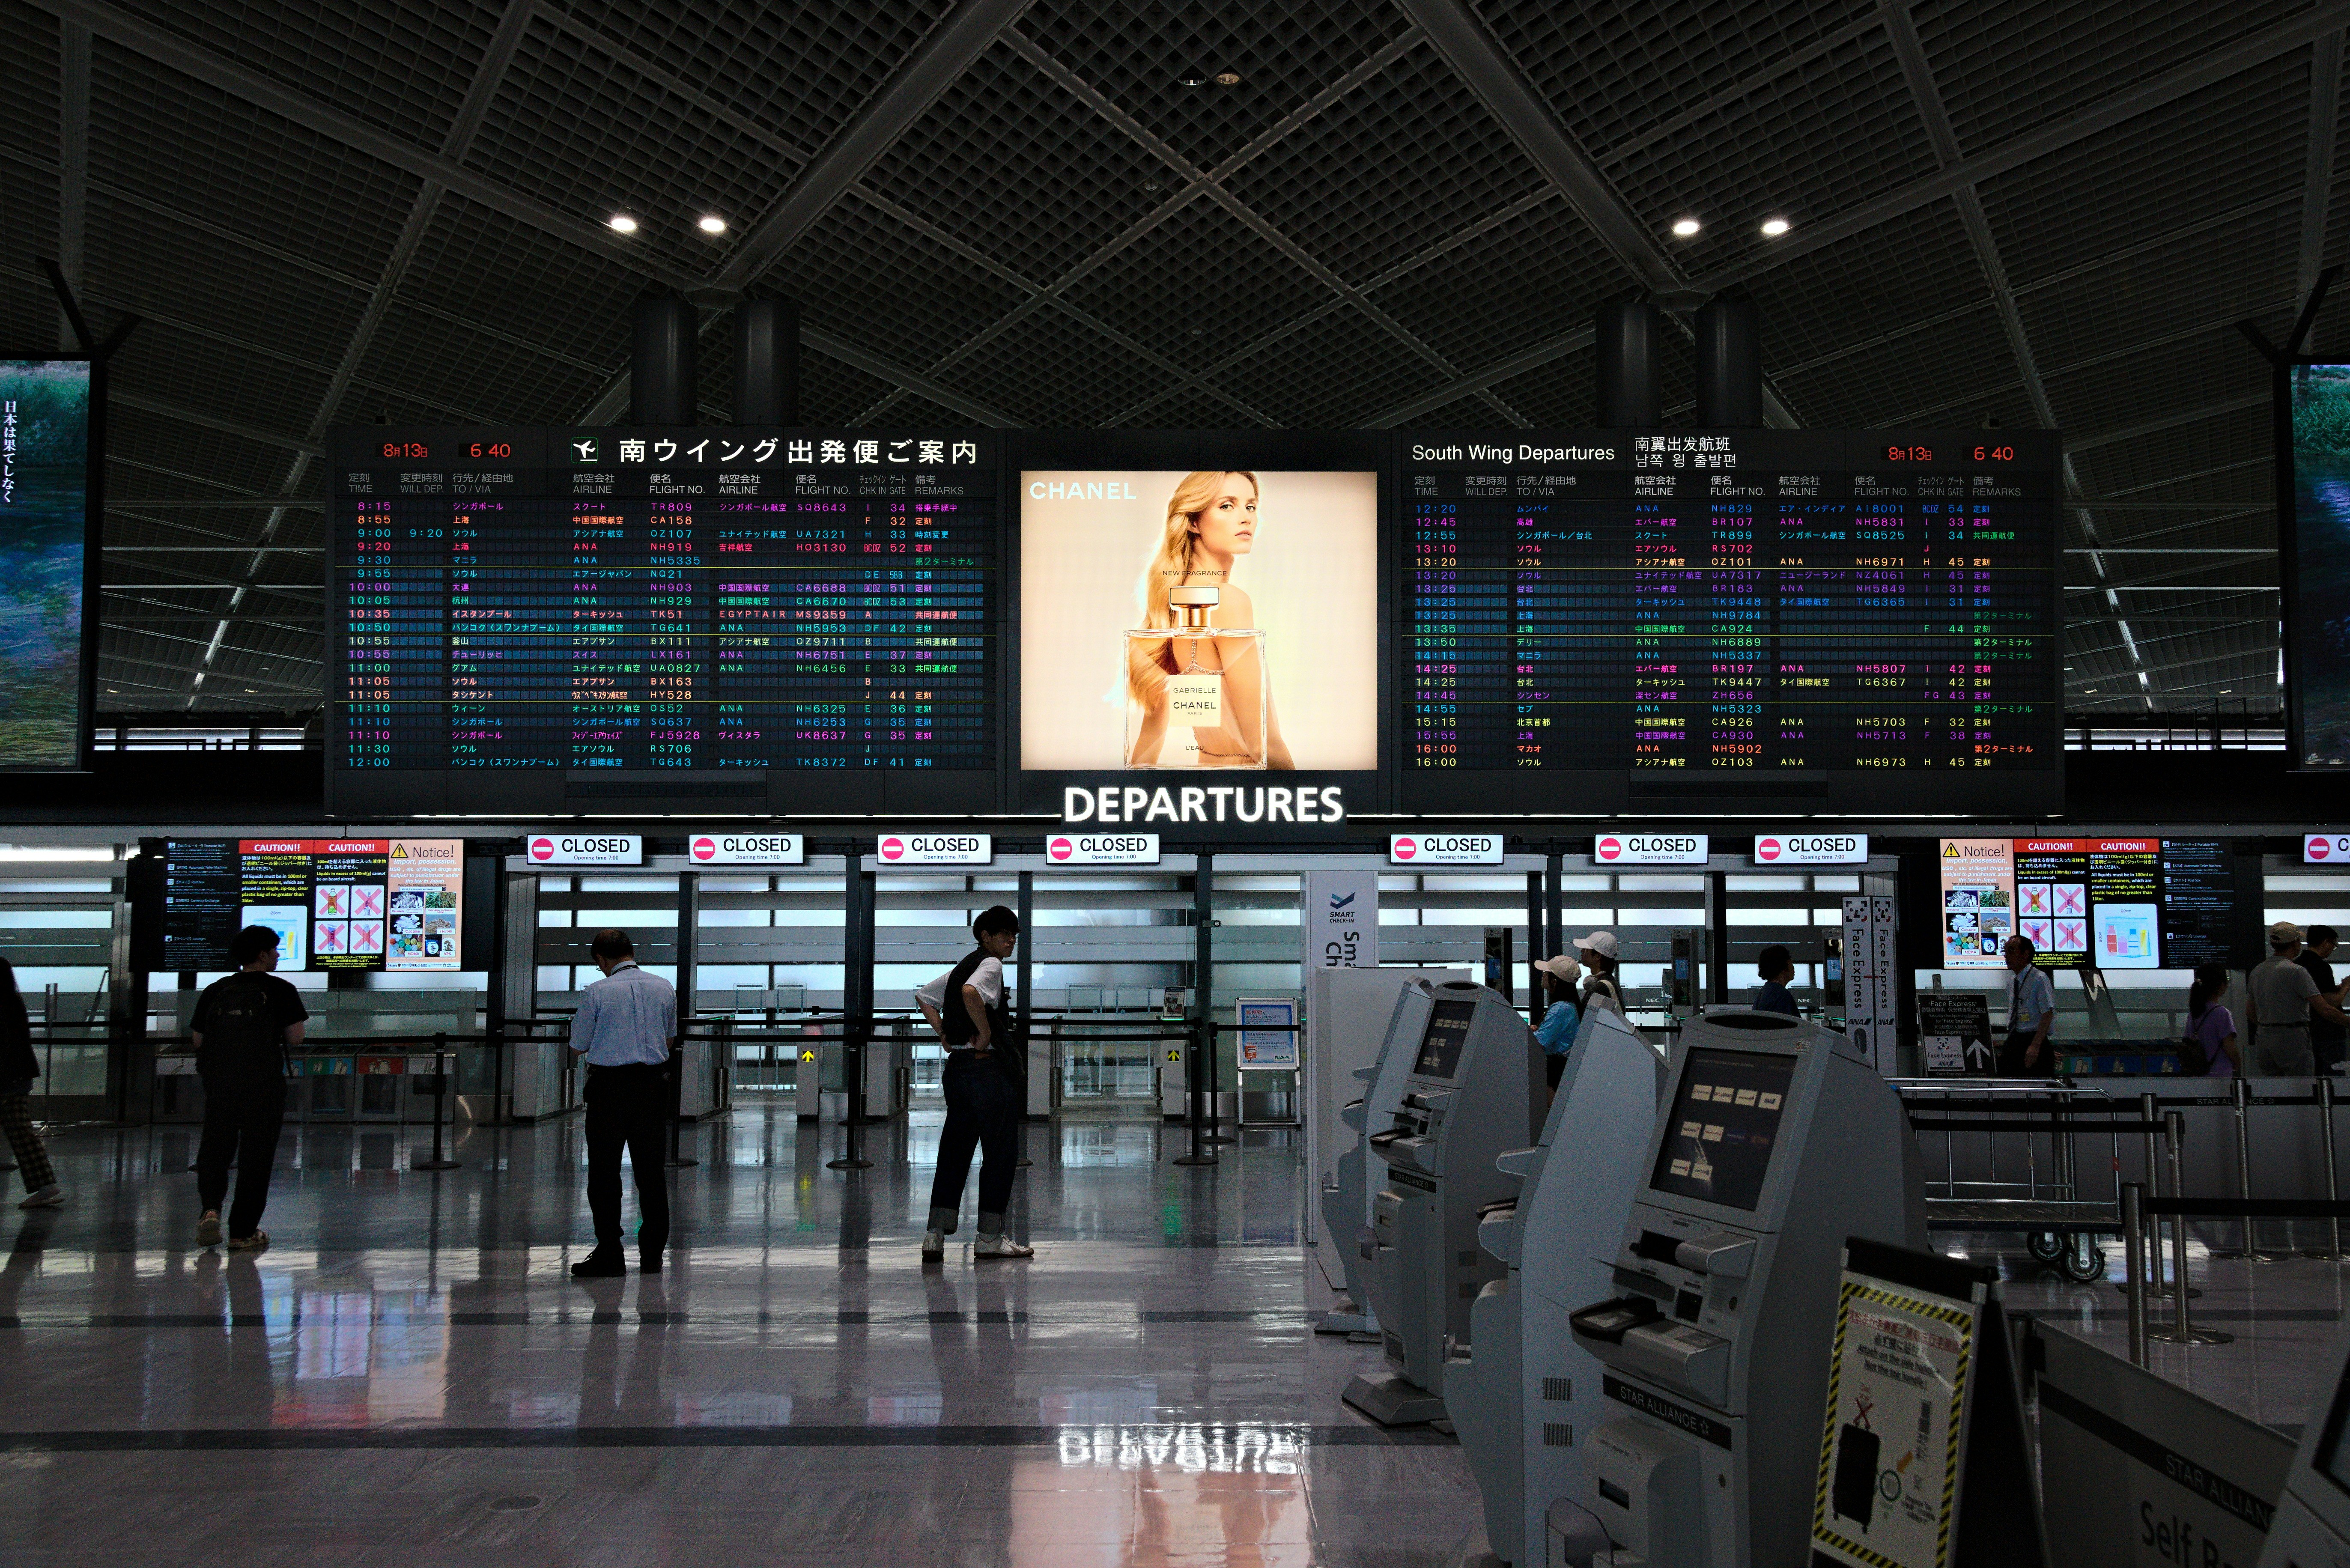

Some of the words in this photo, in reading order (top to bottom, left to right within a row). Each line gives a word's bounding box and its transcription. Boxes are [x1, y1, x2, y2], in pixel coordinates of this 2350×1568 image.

[1635, 436, 1730, 452] 南翼出发航班
[2, 400, 18, 503] 日本は果てしなく
[384, 443, 428, 457] 8月13日
[471, 444, 481, 457] 6
[488, 444, 510, 457] 40
[620, 438, 976, 464] 南ウイング出発便ご案内
[1412, 445, 1462, 460] South
[1468, 445, 1512, 464] Wing
[1519, 445, 1614, 464] Departures
[1889, 447, 1932, 460] 8月13日
[1974, 447, 1985, 460] 6
[1992, 447, 2013, 460] 40
[1636, 454, 1663, 468] 남쪽
[1672, 453, 1685, 468] 윙
[1694, 453, 1736, 468] 출발편
[349, 473, 370, 482] 定刻
[400, 473, 442, 483] 変更時刻
[573, 473, 615, 483] 航空会社
[915, 475, 936, 484] 備考
[1634, 475, 1676, 485] 航空会社
[349, 484, 373, 492] TIME
[400, 485, 421, 493] WILL
[423, 485, 444, 493] DEP.
[573, 485, 612, 493] AIRLINE
[650, 485, 685, 494] FLIGHT
[688, 485, 705, 494] NO.
[859, 486, 877, 495] CHK
[889, 486, 906, 495] GATE
[915, 486, 963, 495] REMARKS
[1029, 481, 1138, 501] CHANEL
[1635, 487, 1673, 495] AIRLINE
[1973, 488, 2021, 496] REMARKS
[358, 502, 391, 510] 8:15
[798, 503, 846, 512] SQ8643
[891, 504, 905, 512] 34
[916, 504, 957, 512] 搭乗手続中
[1417, 504, 1456, 513] 12:20
[358, 515, 391, 524] 8:55
[453, 516, 469, 524] 上海
[890, 517, 906, 525] 32
[915, 517, 932, 525] 定刻
[1417, 518, 1456, 526] 12:45
[1517, 518, 1533, 526] 高雄
[1856, 518, 1903, 526] NH5831
[358, 529, 391, 537] 9:00
[410, 529, 442, 537] 9:20
[574, 530, 623, 538] アシアナ航空
[797, 530, 844, 539] UA7321
[891, 530, 906, 539] 33
[915, 531, 948, 539] 時刻変更
[1416, 531, 1455, 540] 12:55
[1973, 531, 2014, 540] 共同運航便
[358, 542, 391, 551] 9:20
[719, 543, 752, 551] 吉祥航空
[796, 543, 846, 552] HO3130
[890, 543, 906, 552] 52
[915, 557, 974, 566] 第2ターミナル
[1856, 557, 1903, 566] NH6971
[1948, 557, 1964, 566] 45
[350, 583, 390, 591] 10:00
[453, 583, 469, 591] 大連
[349, 609, 390, 618] 10:35
[796, 610, 846, 620] MS9359
[1416, 624, 1455, 633] 13:35
[1949, 625, 1964, 633] 44
[452, 637, 468, 645] 釜山
[796, 637, 844, 646] OZ9711
[915, 638, 957, 646] 共同運航便
[796, 664, 846, 673] NH6456
[1857, 664, 1906, 673] NH5807
[890, 691, 905, 700] 44
[915, 691, 932, 700] 定刻
[349, 704, 390, 712] 11:10
[796, 704, 845, 713] NH6325
[1417, 718, 1456, 726] 15:15
[1517, 718, 1551, 727] 北京首都
[1635, 718, 1685, 726] 中国国際航空
[1857, 718, 1906, 727] NH5703
[349, 731, 390, 739] 11:10
[1417, 744, 1456, 753] 16:00
[1974, 745, 2033, 753] 第2ターミナル
[796, 758, 845, 766] TK8372
[1857, 758, 1906, 766] NH6973
[1064, 787, 1343, 823] DEPARTURES
[254, 844, 300, 852] CAUTION!!
[329, 844, 375, 852] CAUTION!!
[562, 838, 630, 853] CLOSED
[723, 838, 791, 852] CLOSED
[912, 838, 979, 852] CLOSED
[1080, 838, 1147, 852] CLOSED
[1424, 838, 1491, 852] CLOSED
[1629, 838, 1696, 852] CLOSED
[1789, 838, 1856, 852] CLOSED
[413, 845, 454, 858] Notice!
[1964, 844, 2004, 857] Notice!
[1852, 929, 1864, 957] Face
[1879, 929, 1889, 957] Face
[1851, 960, 1865, 1009] Express
[1879, 960, 1889, 1009] Express
[1405, 1176, 1424, 1186] ALLIANCE
[1620, 1386, 1645, 1406] STAR
[1647, 1398, 1697, 1431] ALLIANCE
[2165, 1454, 2205, 1492] STAR
[2210, 1478, 2275, 1532] ALLIAN
